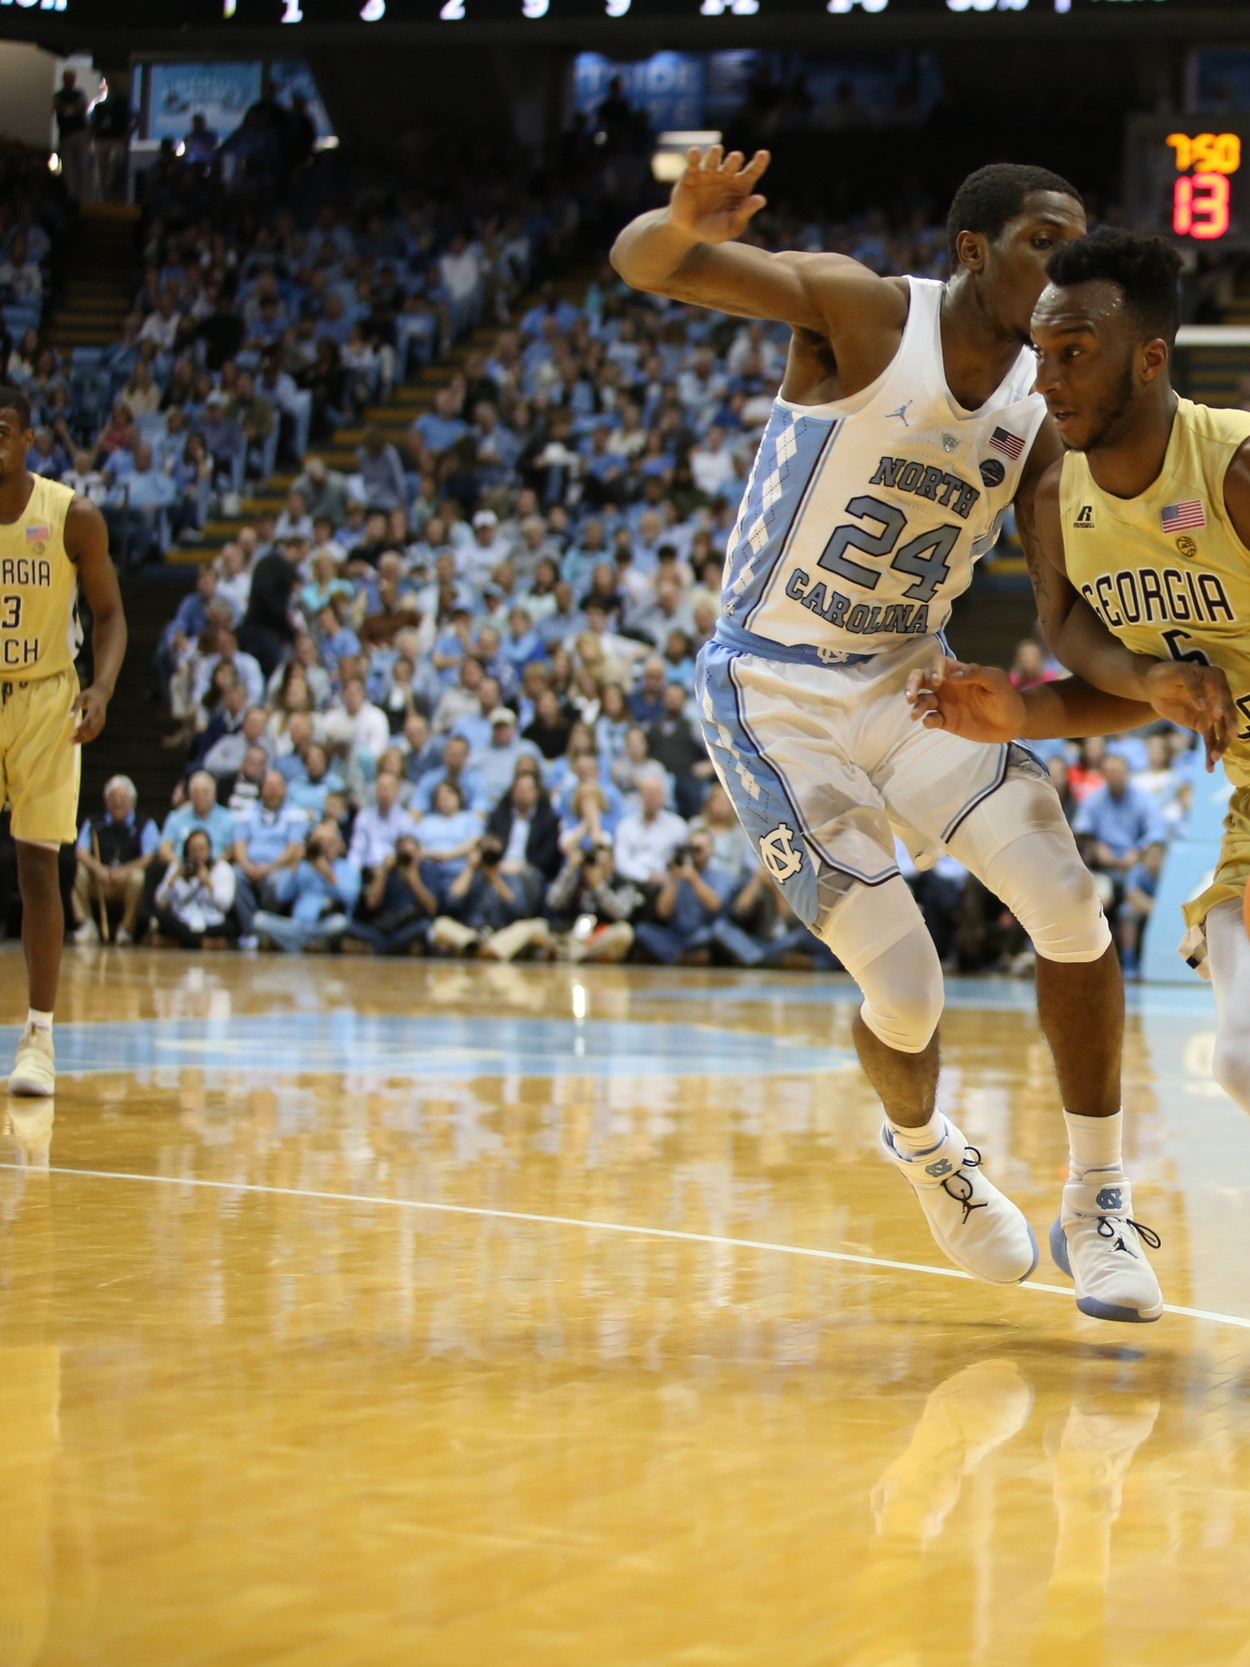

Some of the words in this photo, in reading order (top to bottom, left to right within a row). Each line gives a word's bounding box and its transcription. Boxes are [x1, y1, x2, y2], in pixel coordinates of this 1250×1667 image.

[1173, 173, 1230, 240] 13
[869, 456, 980, 519] NORTH
[817, 495, 962, 602] 24
[1, 595, 22, 630] 3
[785, 568, 930, 634] CAROLINA
